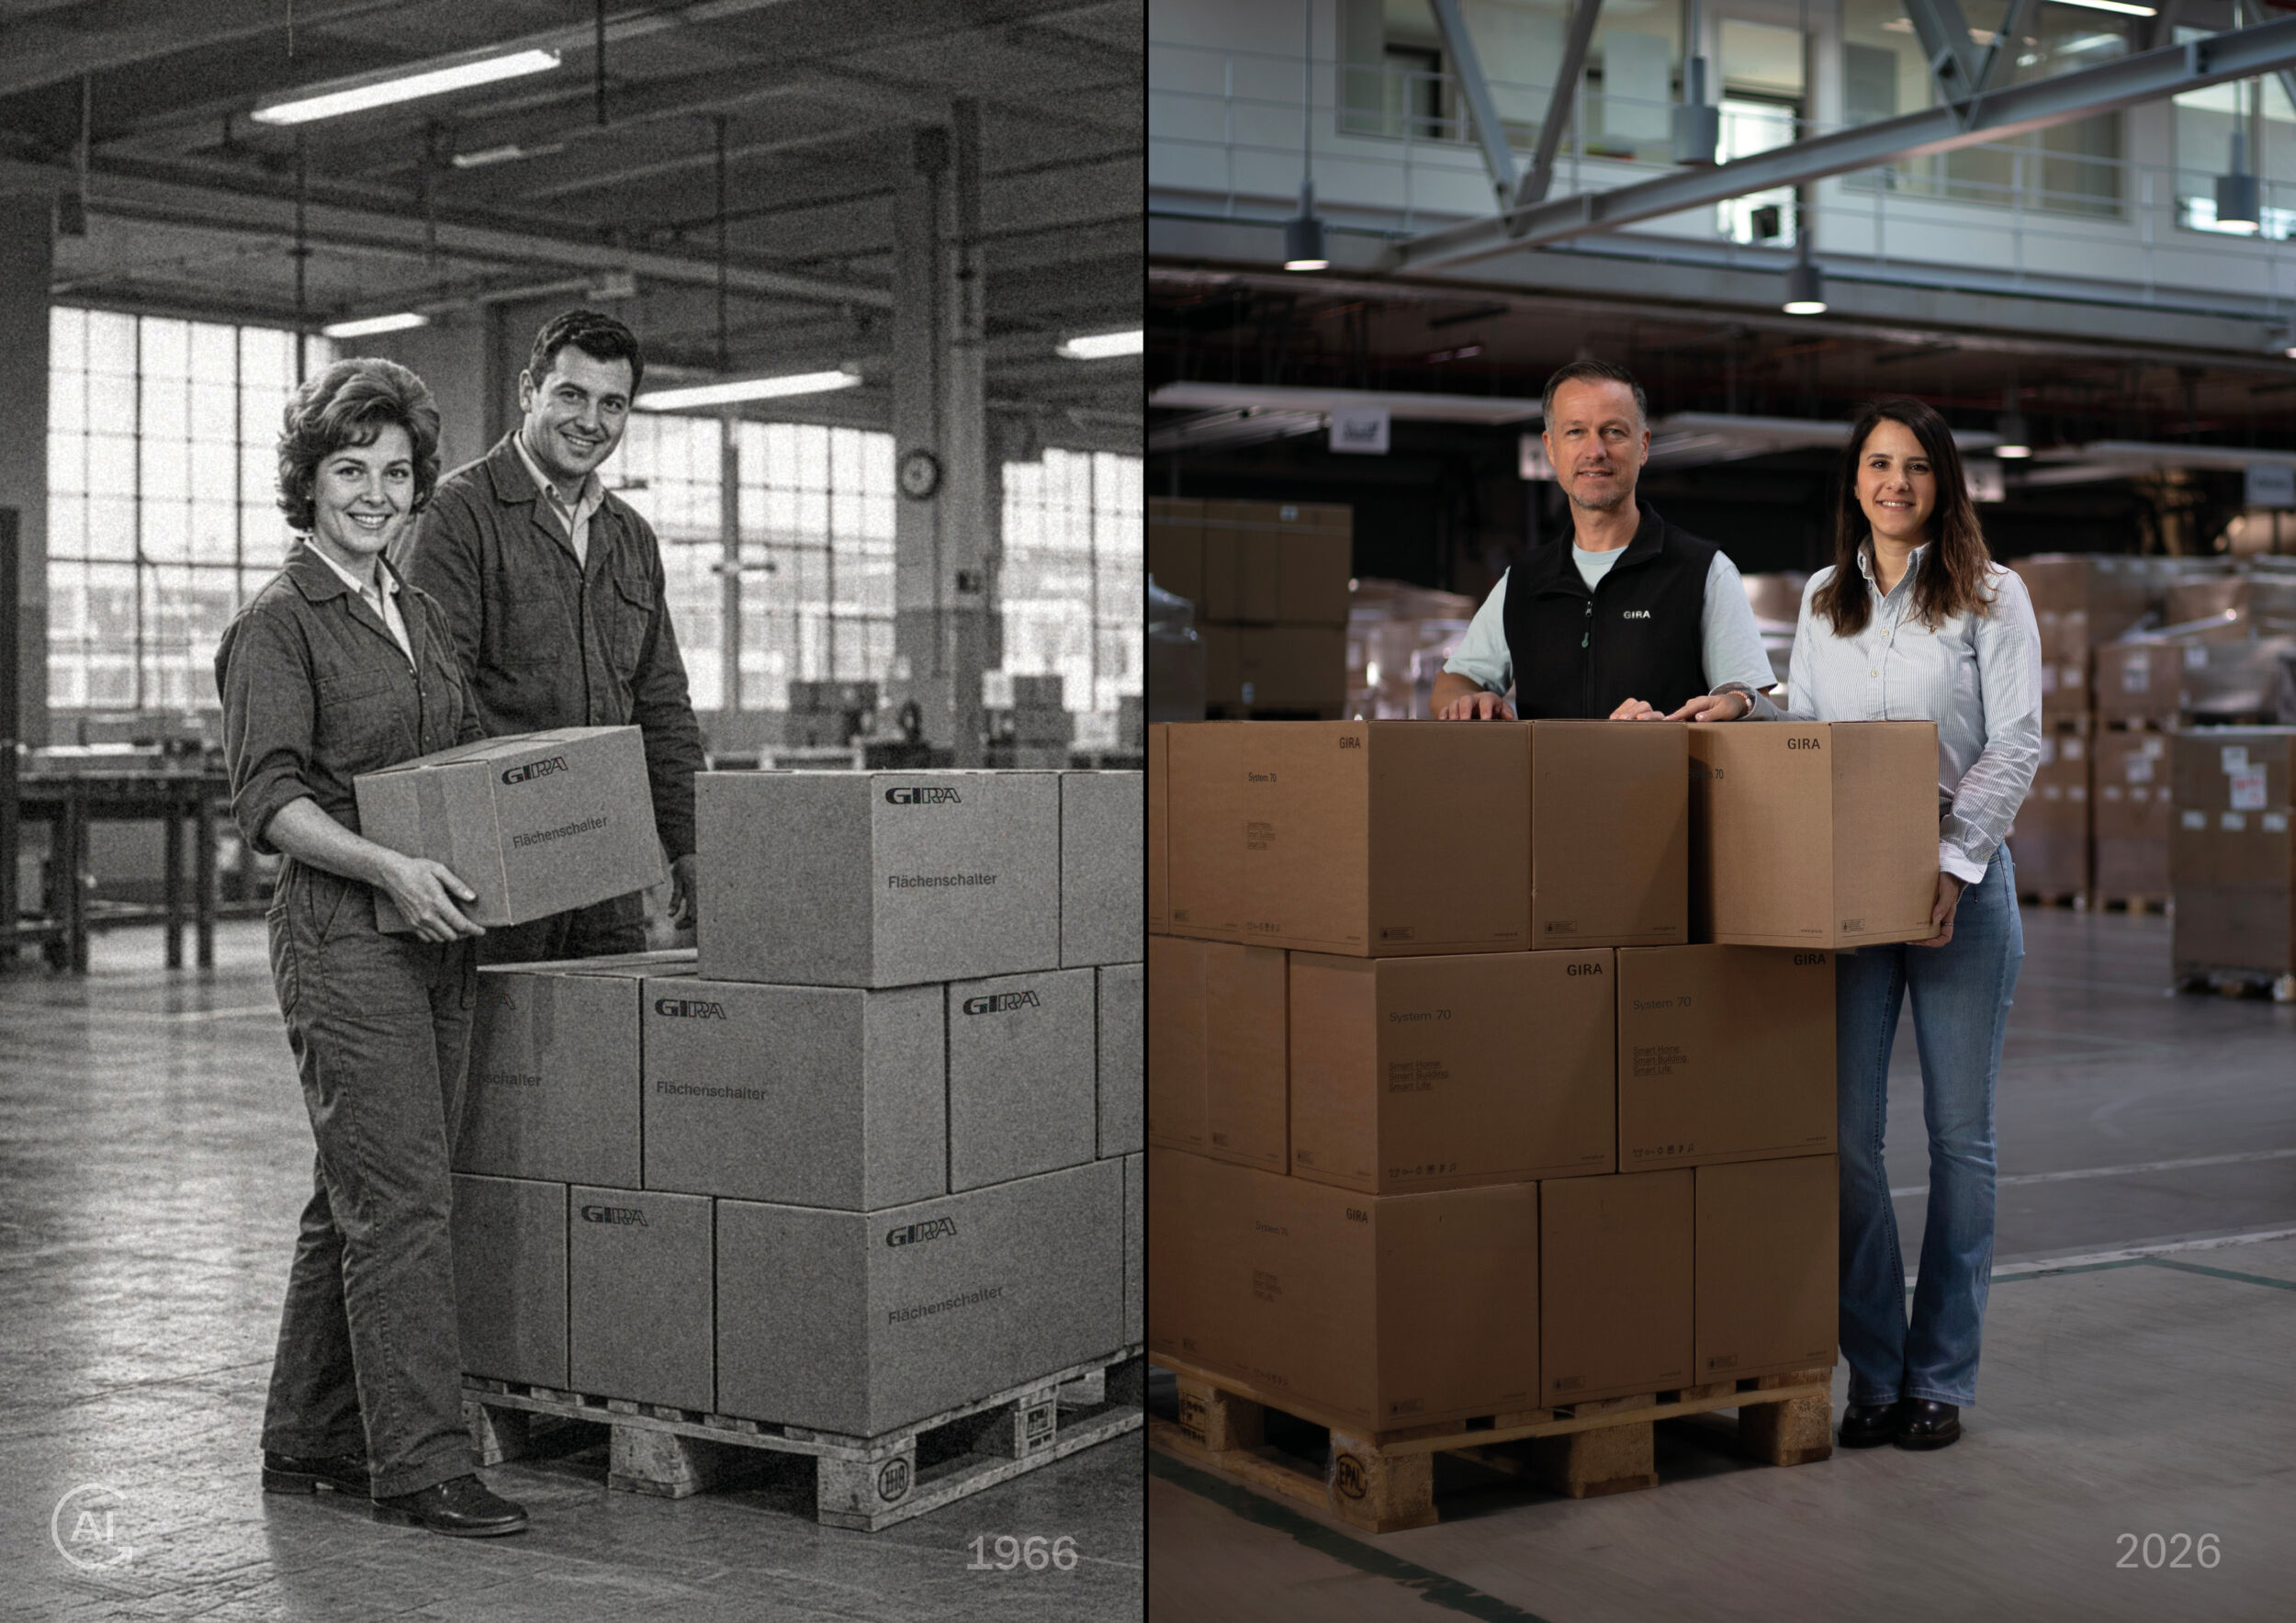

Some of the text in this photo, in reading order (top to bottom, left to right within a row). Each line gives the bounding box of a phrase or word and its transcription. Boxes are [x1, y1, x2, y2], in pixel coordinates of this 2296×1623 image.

[1623, 610, 1651, 619] GIRA
[1339, 737, 1361, 750] GIRA
[1787, 738, 1820, 750] GIRA
[501, 756, 568, 785] GIRA
[1269, 772, 1277, 783] 70
[884, 787, 962, 805] GIRA
[512, 817, 607, 849] Flächenschalter
[888, 873, 997, 889] Flächenschalter
[1794, 953, 1826, 966] GIRA
[1566, 964, 1604, 976] GIRA
[655, 998, 727, 1020] GIRA
[962, 990, 1041, 1015] GIRA
[1632, 997, 1692, 1011] System 70
[1389, 1009, 1452, 1024] System 70
[656, 1080, 769, 1100] Flächenschalter
[580, 1205, 648, 1227] GIRA
[1345, 1207, 1368, 1223] GIRA
[885, 1216, 957, 1247] GIRA
[888, 1286, 1003, 1325] Flächenschalter
